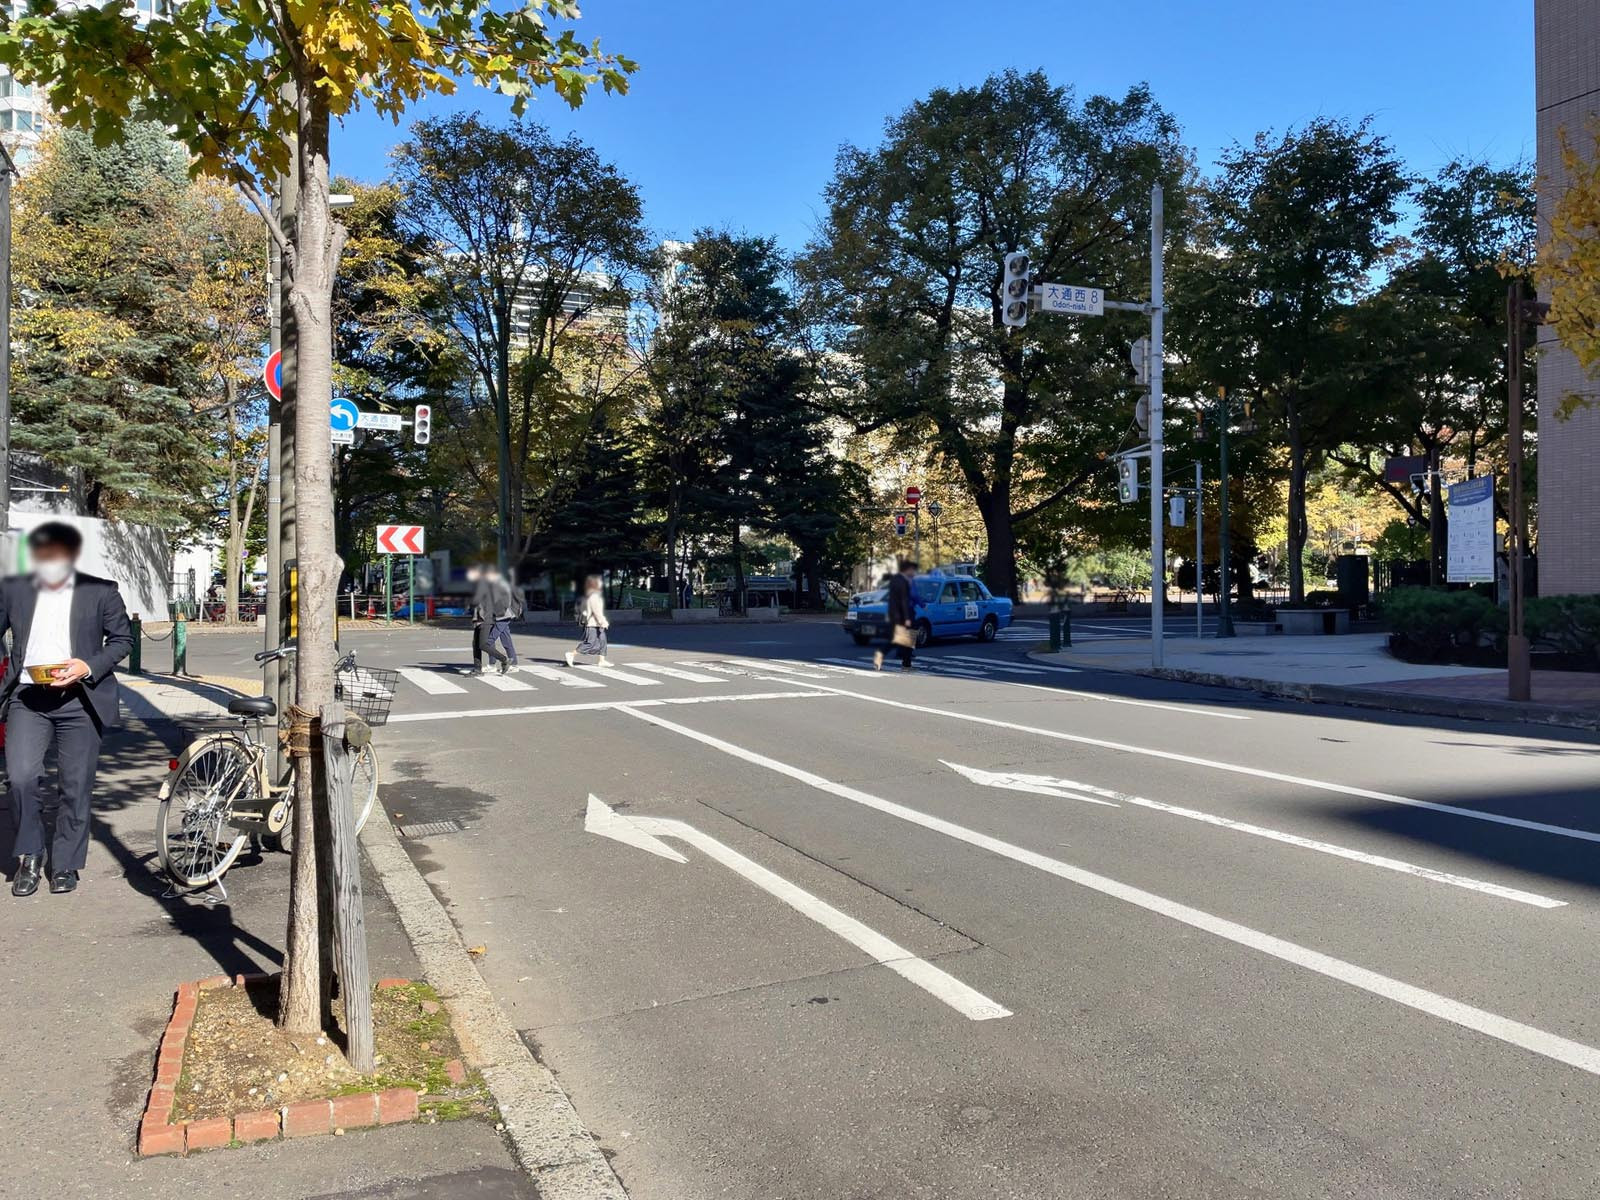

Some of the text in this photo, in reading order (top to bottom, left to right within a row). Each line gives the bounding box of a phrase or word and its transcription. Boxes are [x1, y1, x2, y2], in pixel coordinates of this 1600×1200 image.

[1048, 286, 1098, 303] 大通西 8
